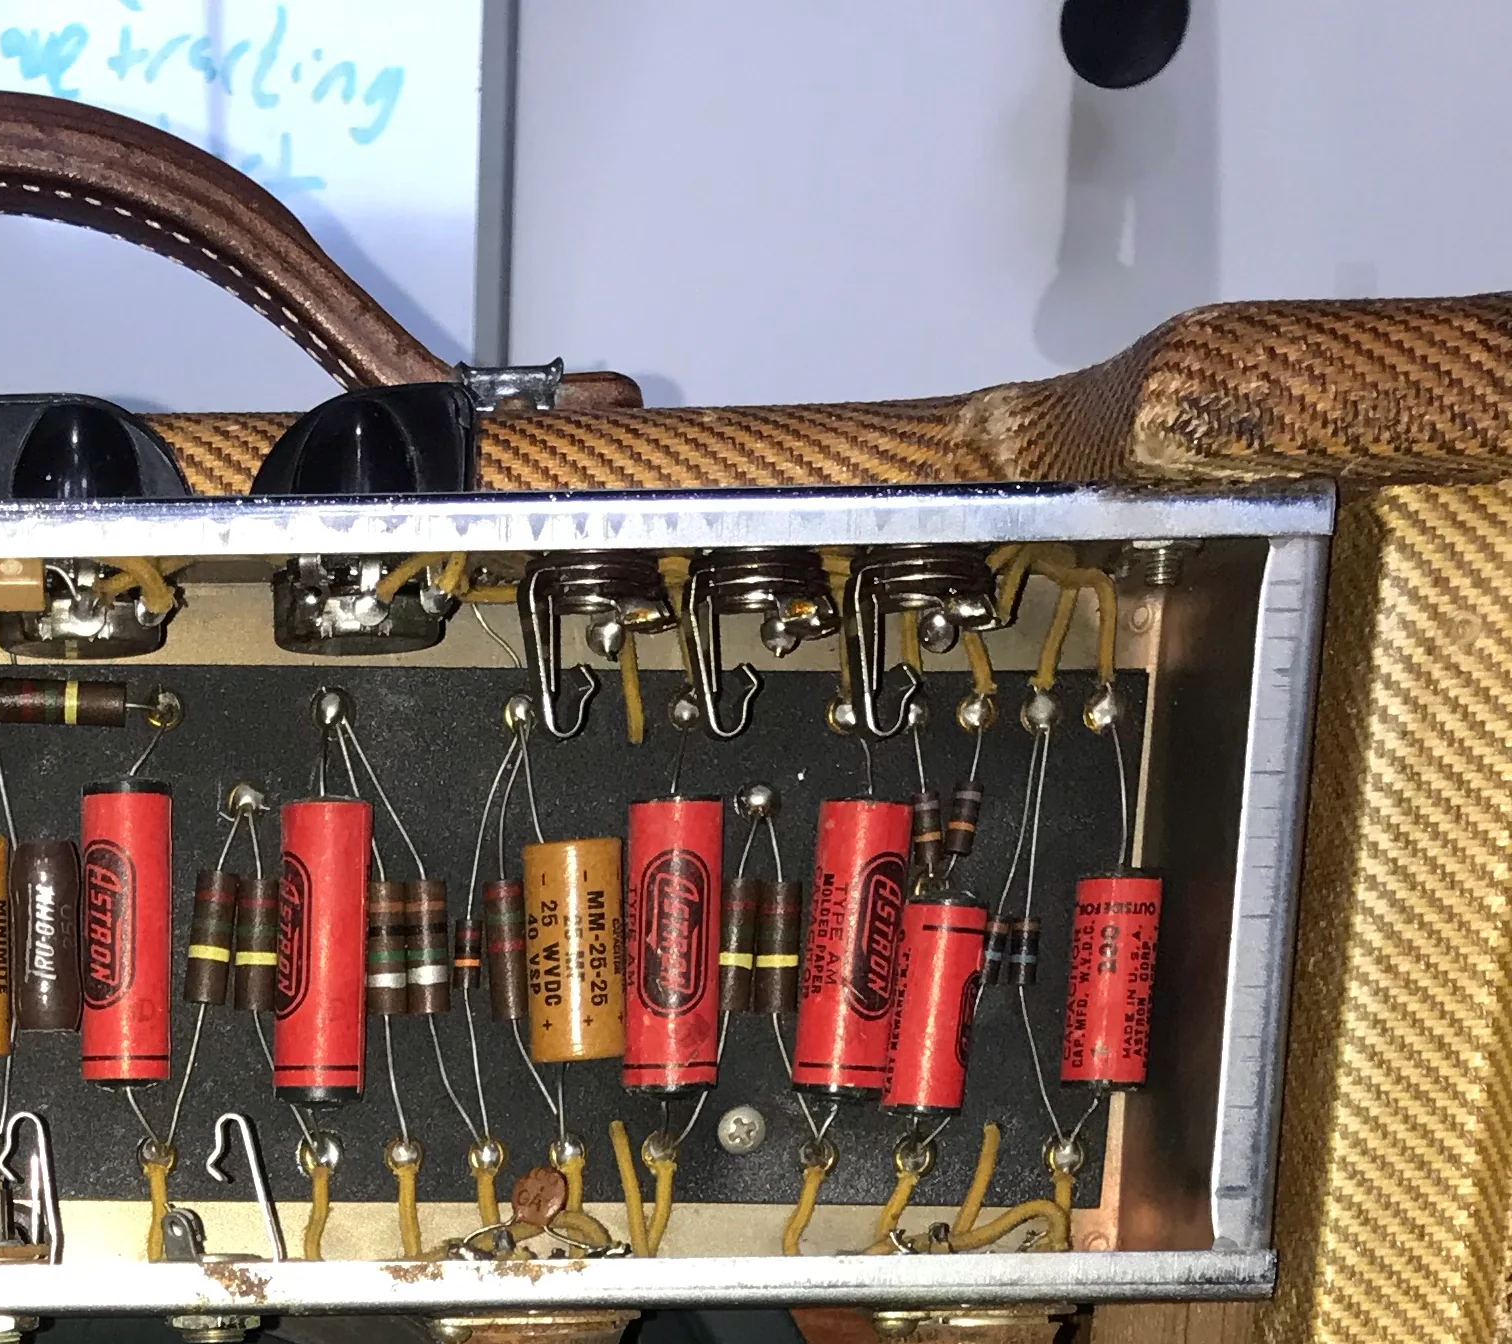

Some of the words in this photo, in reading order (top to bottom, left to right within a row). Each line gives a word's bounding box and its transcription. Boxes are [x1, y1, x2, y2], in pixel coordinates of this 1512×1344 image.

[85, 864, 122, 985] ASTRON
[278, 873, 299, 995] ASTRON
[527, 913, 538, 940] 40
[540, 899, 557, 927] 25
[653, 873, 699, 993] ASTRON
[817, 873, 834, 937] MOLDED
[828, 882, 848, 940] TYPE
[586, 890, 608, 1006] MM-25-25
[862, 875, 901, 997] ASTRON
[529, 953, 541, 995] VSP
[542, 942, 561, 1006] WVDC
[810, 944, 826, 993] PAPER
[824, 951, 840, 984] AM
[1126, 989, 1136, 1004] IN
[1122, 1012, 1134, 1058] MADE
[1133, 996, 1146, 1056] ASTRON
